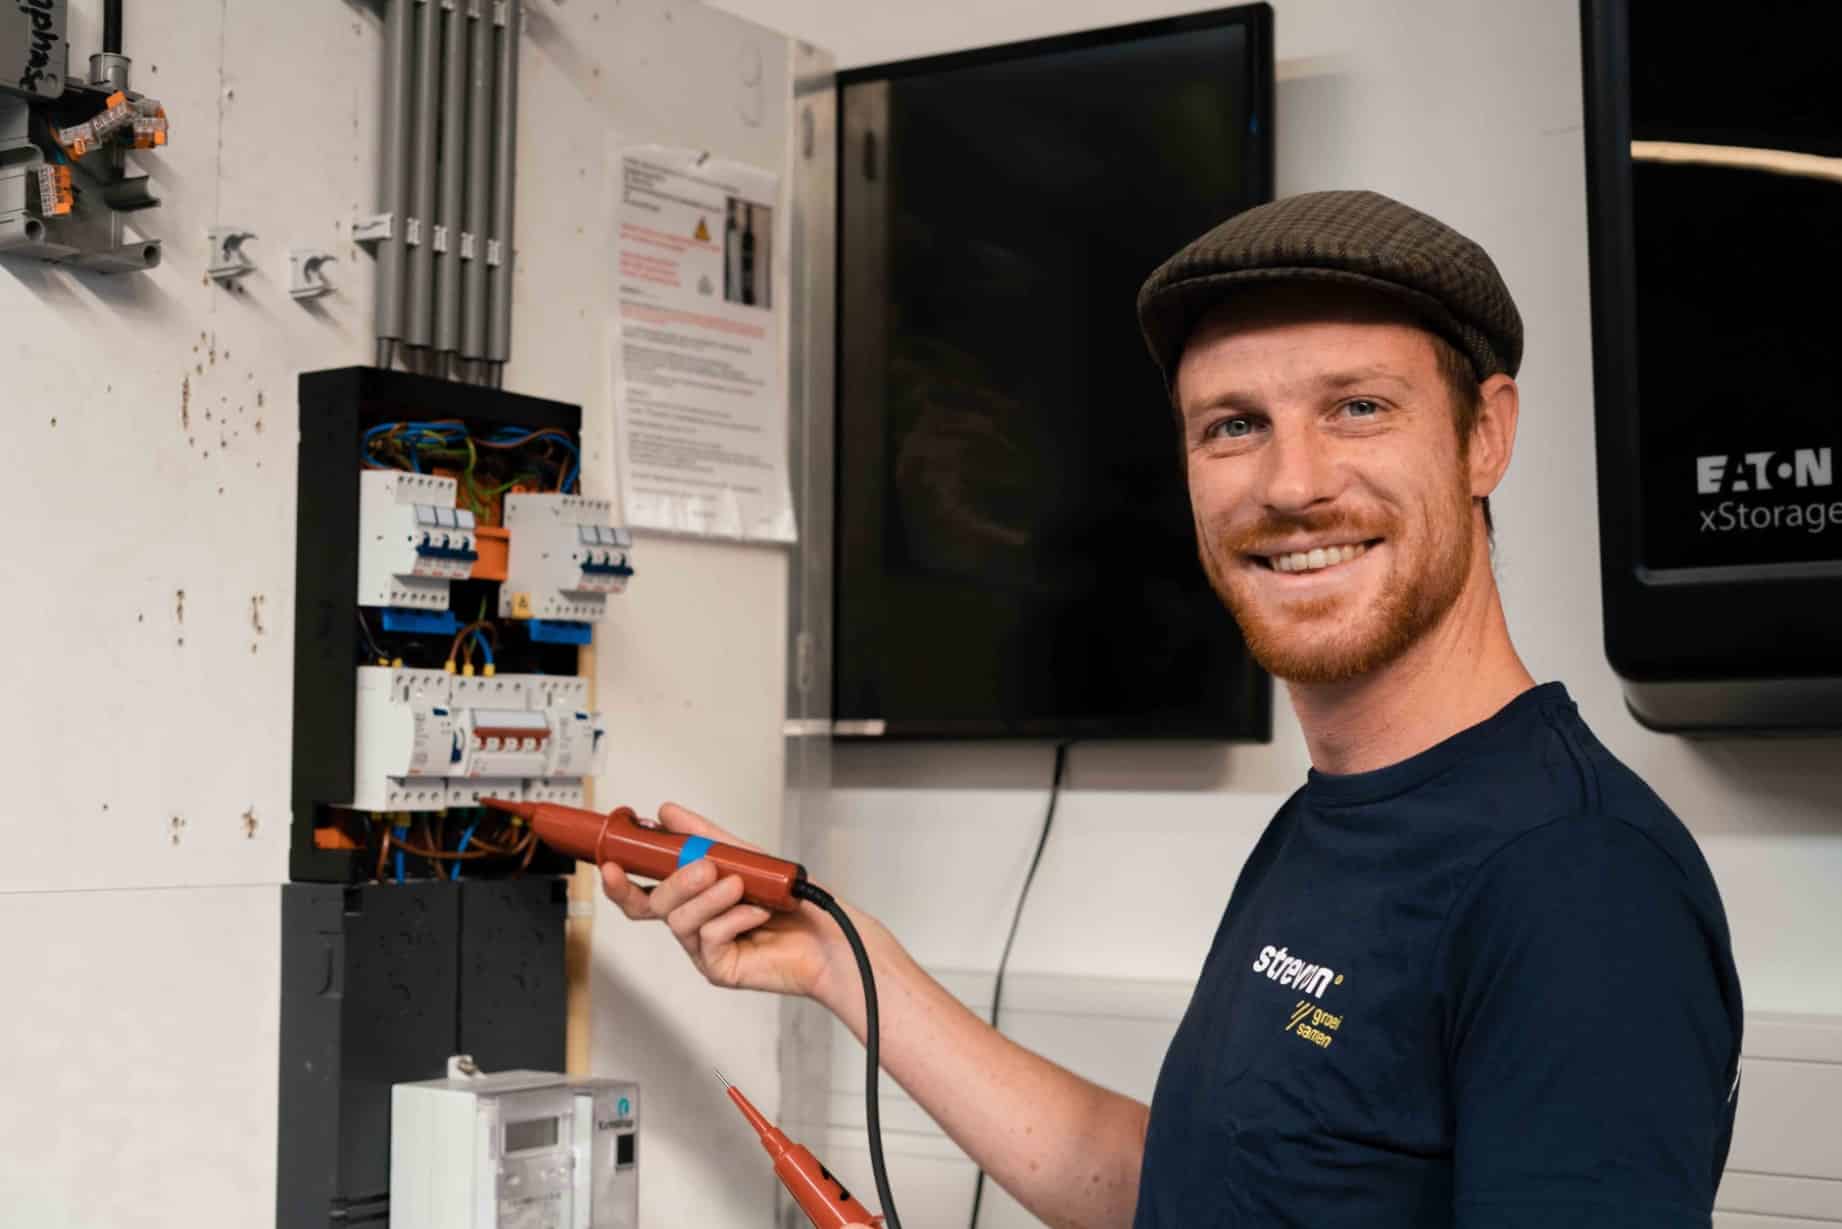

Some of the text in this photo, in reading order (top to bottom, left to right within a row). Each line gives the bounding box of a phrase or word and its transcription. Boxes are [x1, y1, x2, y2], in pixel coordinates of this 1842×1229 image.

[1696, 447, 1833, 495] EATON
[1699, 501, 1842, 534] xStorage
[1312, 1008, 1344, 1031] groei
[1296, 1023, 1333, 1049] samen
